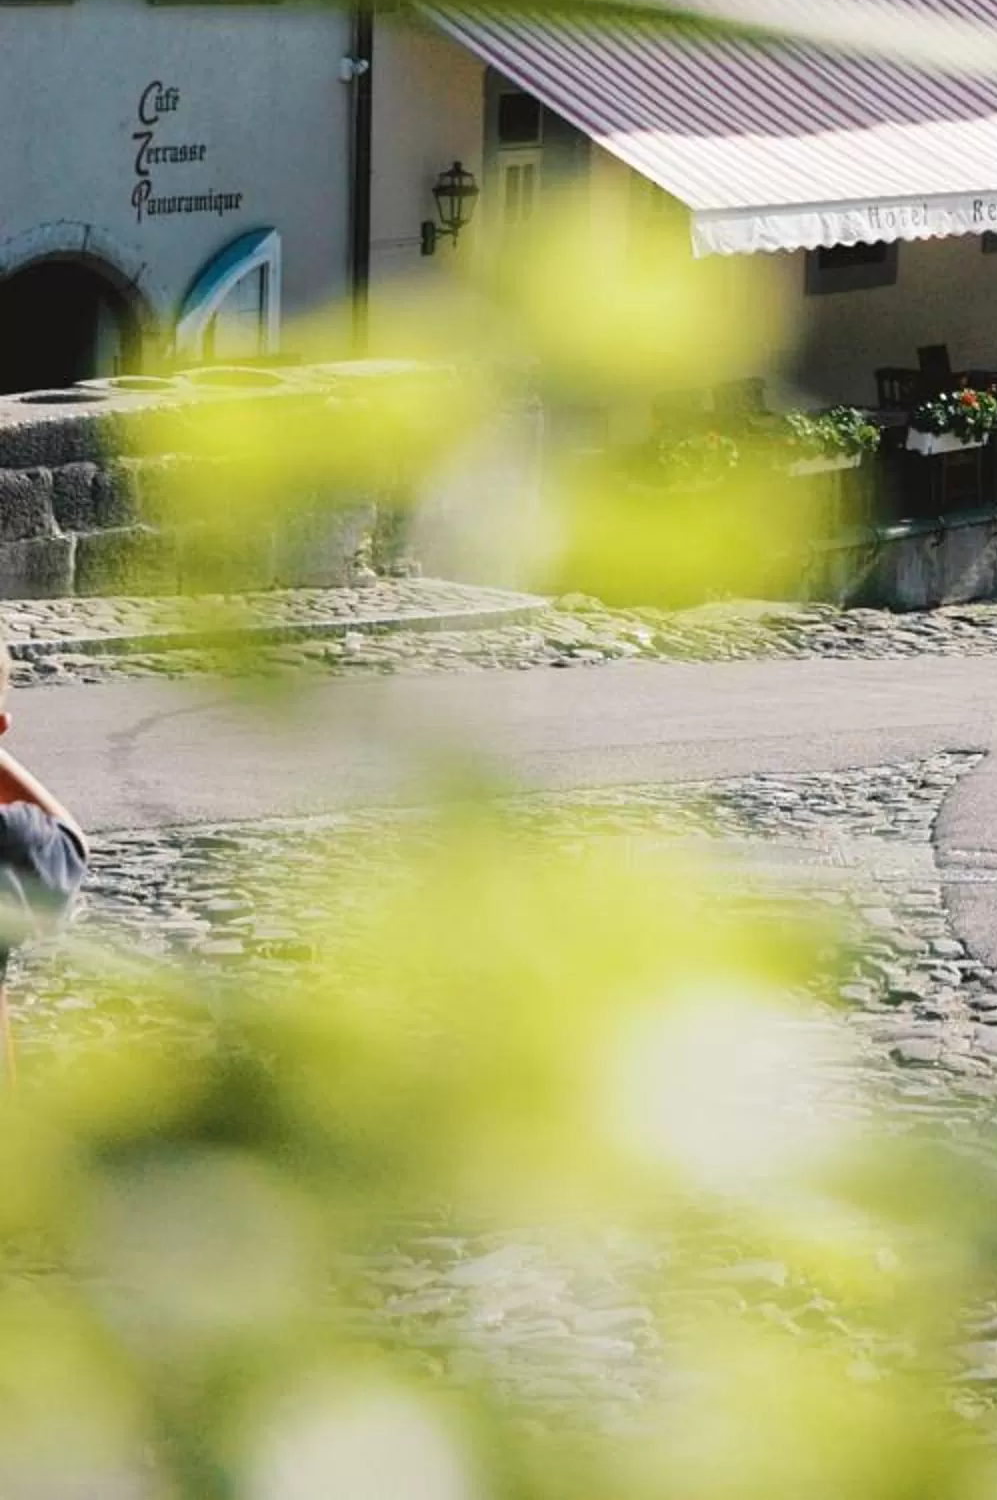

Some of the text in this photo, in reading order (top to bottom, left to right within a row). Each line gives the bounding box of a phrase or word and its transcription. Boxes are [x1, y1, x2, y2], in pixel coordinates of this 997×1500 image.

[132, 131, 207, 177] Terrasse
[131, 179, 243, 224] Panoramique
[866, 203, 928, 230] Hotel
